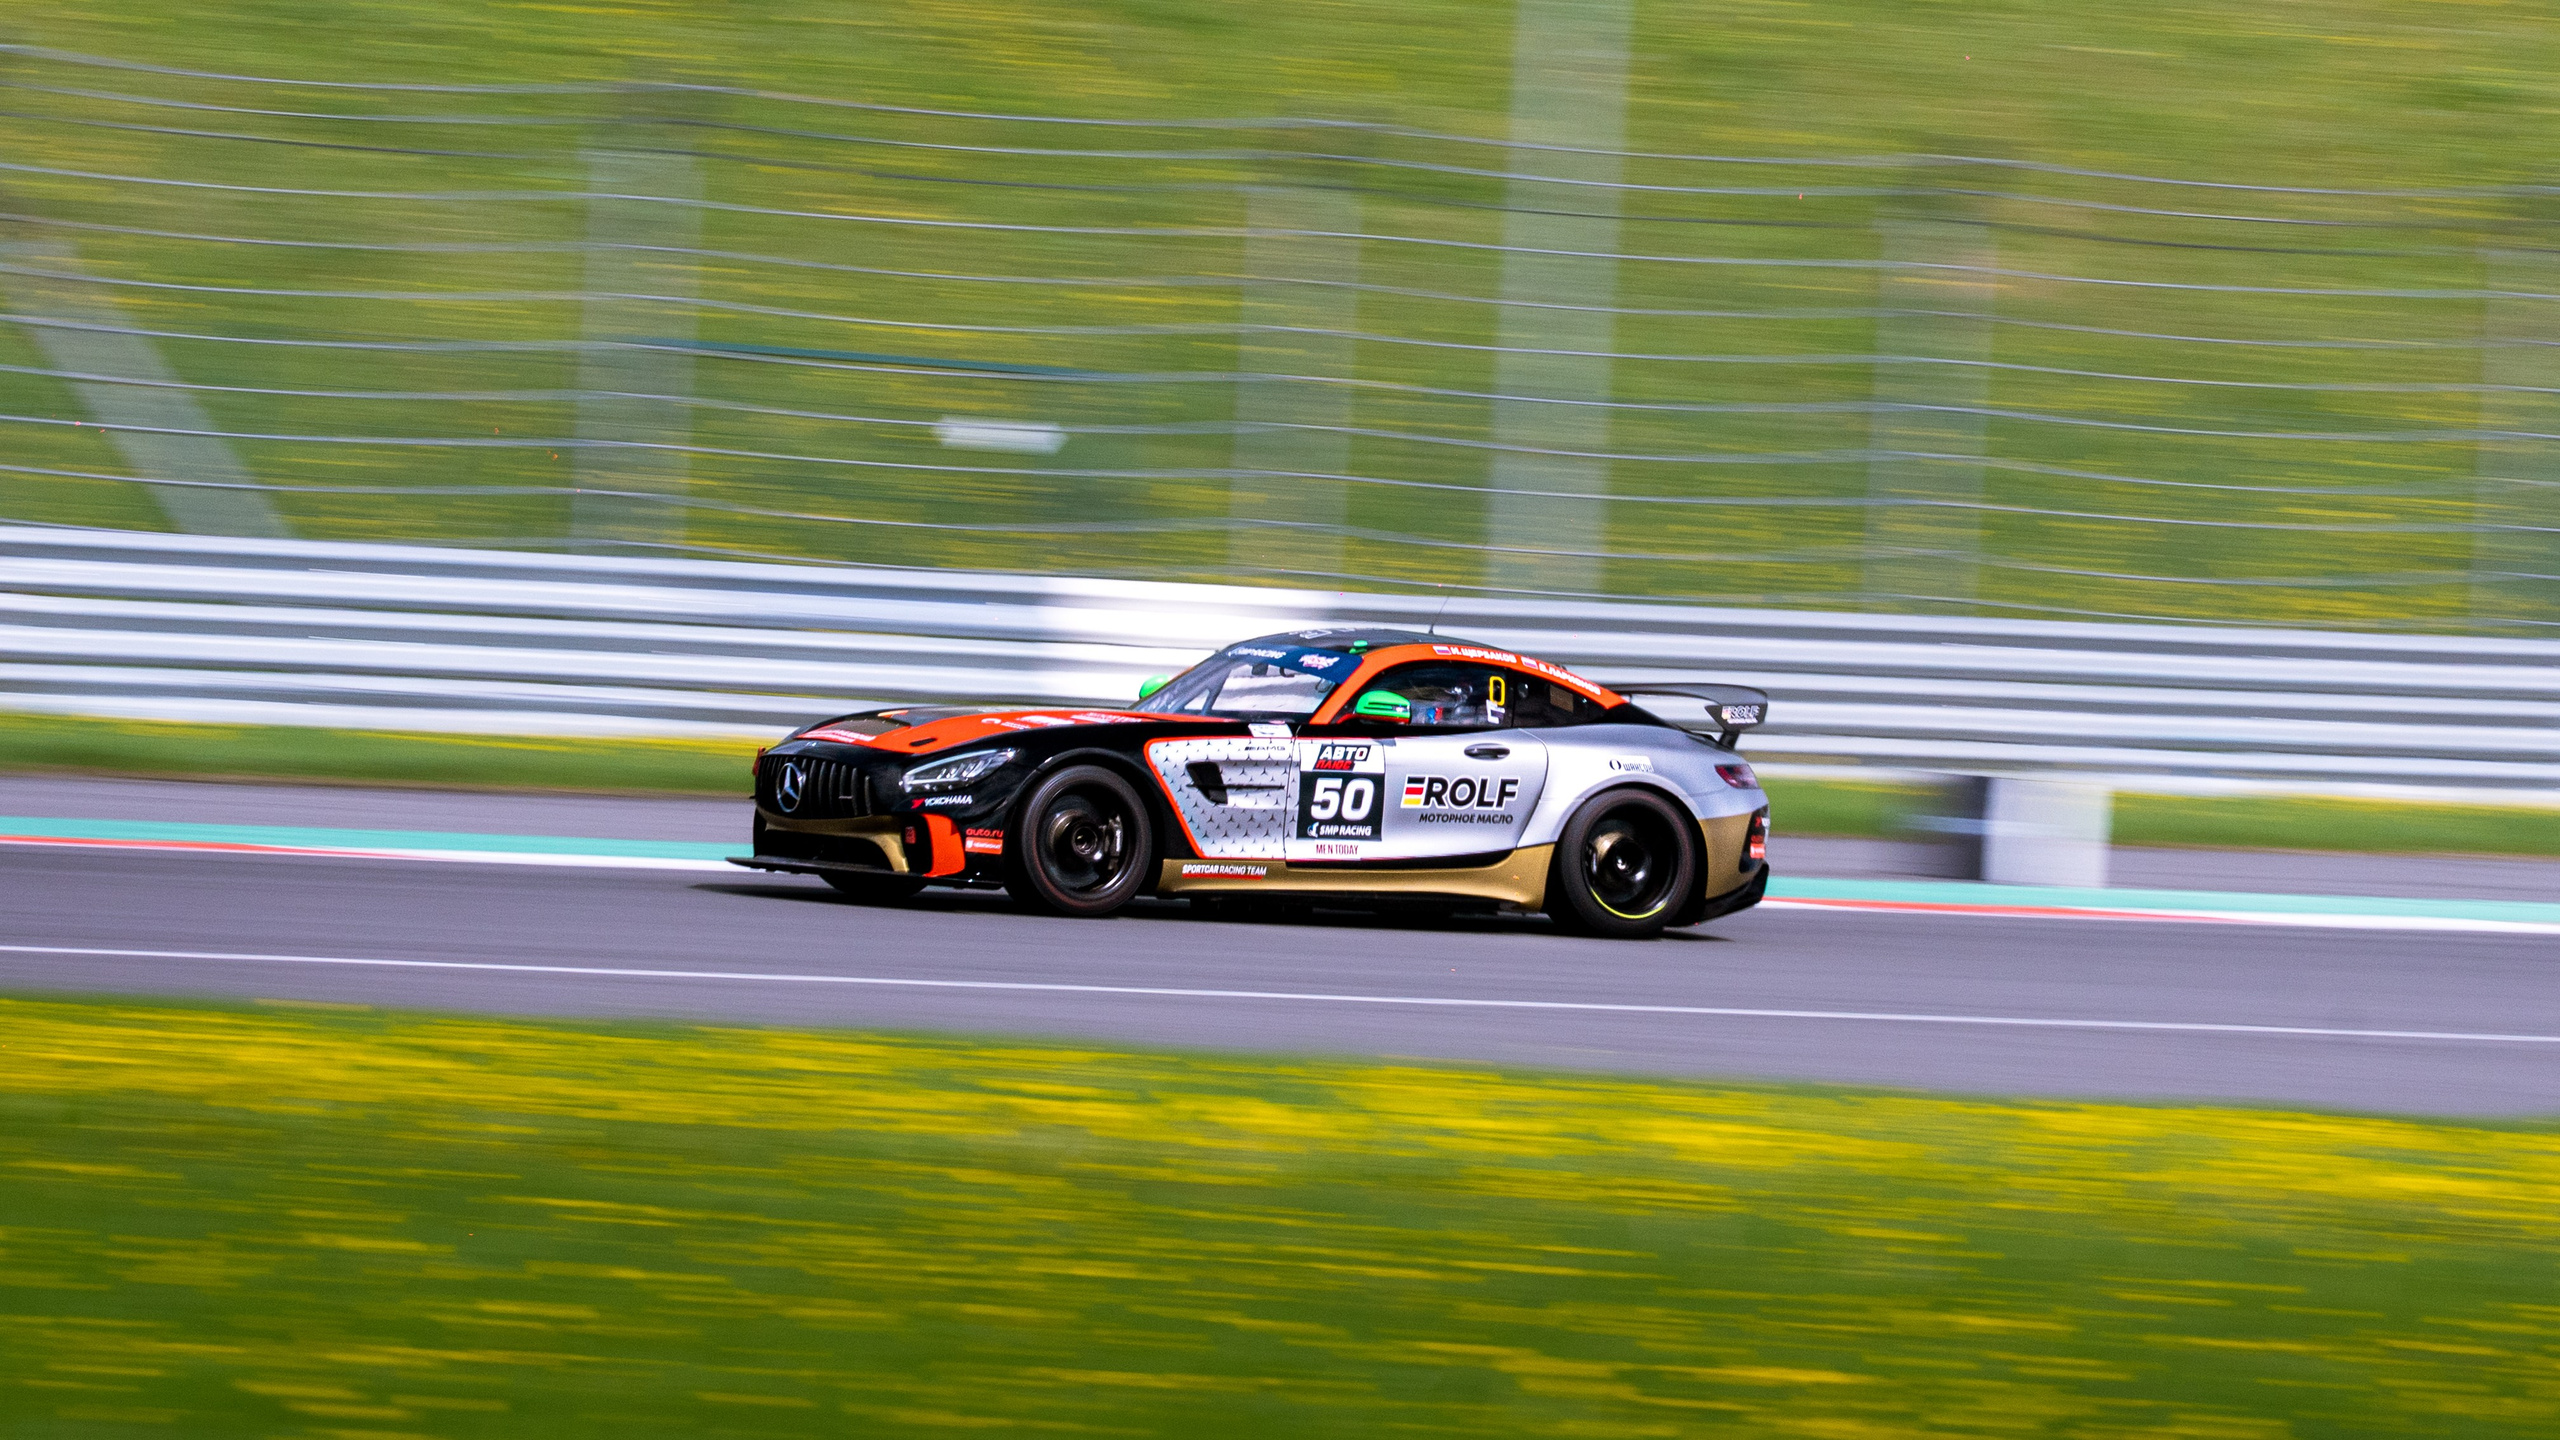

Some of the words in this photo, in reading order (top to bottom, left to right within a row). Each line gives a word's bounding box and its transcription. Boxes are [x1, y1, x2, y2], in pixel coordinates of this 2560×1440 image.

[1319, 746, 1369, 760] АВТО
[1315, 760, 1353, 770] ПЛЮС
[1422, 776, 1520, 809] ROLF
[925, 795, 973, 807] YOKOHAMA
[1311, 777, 1375, 821] 50
[1419, 813, 1476, 824] МОТОРНОЕ
[1477, 814, 1514, 825] МАСЛО
[966, 828, 1004, 838] auto.ru
[1320, 825, 1339, 836] SMP
[1340, 825, 1373, 837] RACING
[1316, 844, 1334, 855] MEN
[1335, 844, 1359, 855] TODAY
[1182, 864, 1219, 874] SPORTCAR
[1219, 864, 1246, 875] RACING
[1247, 866, 1268, 876] TEAM
